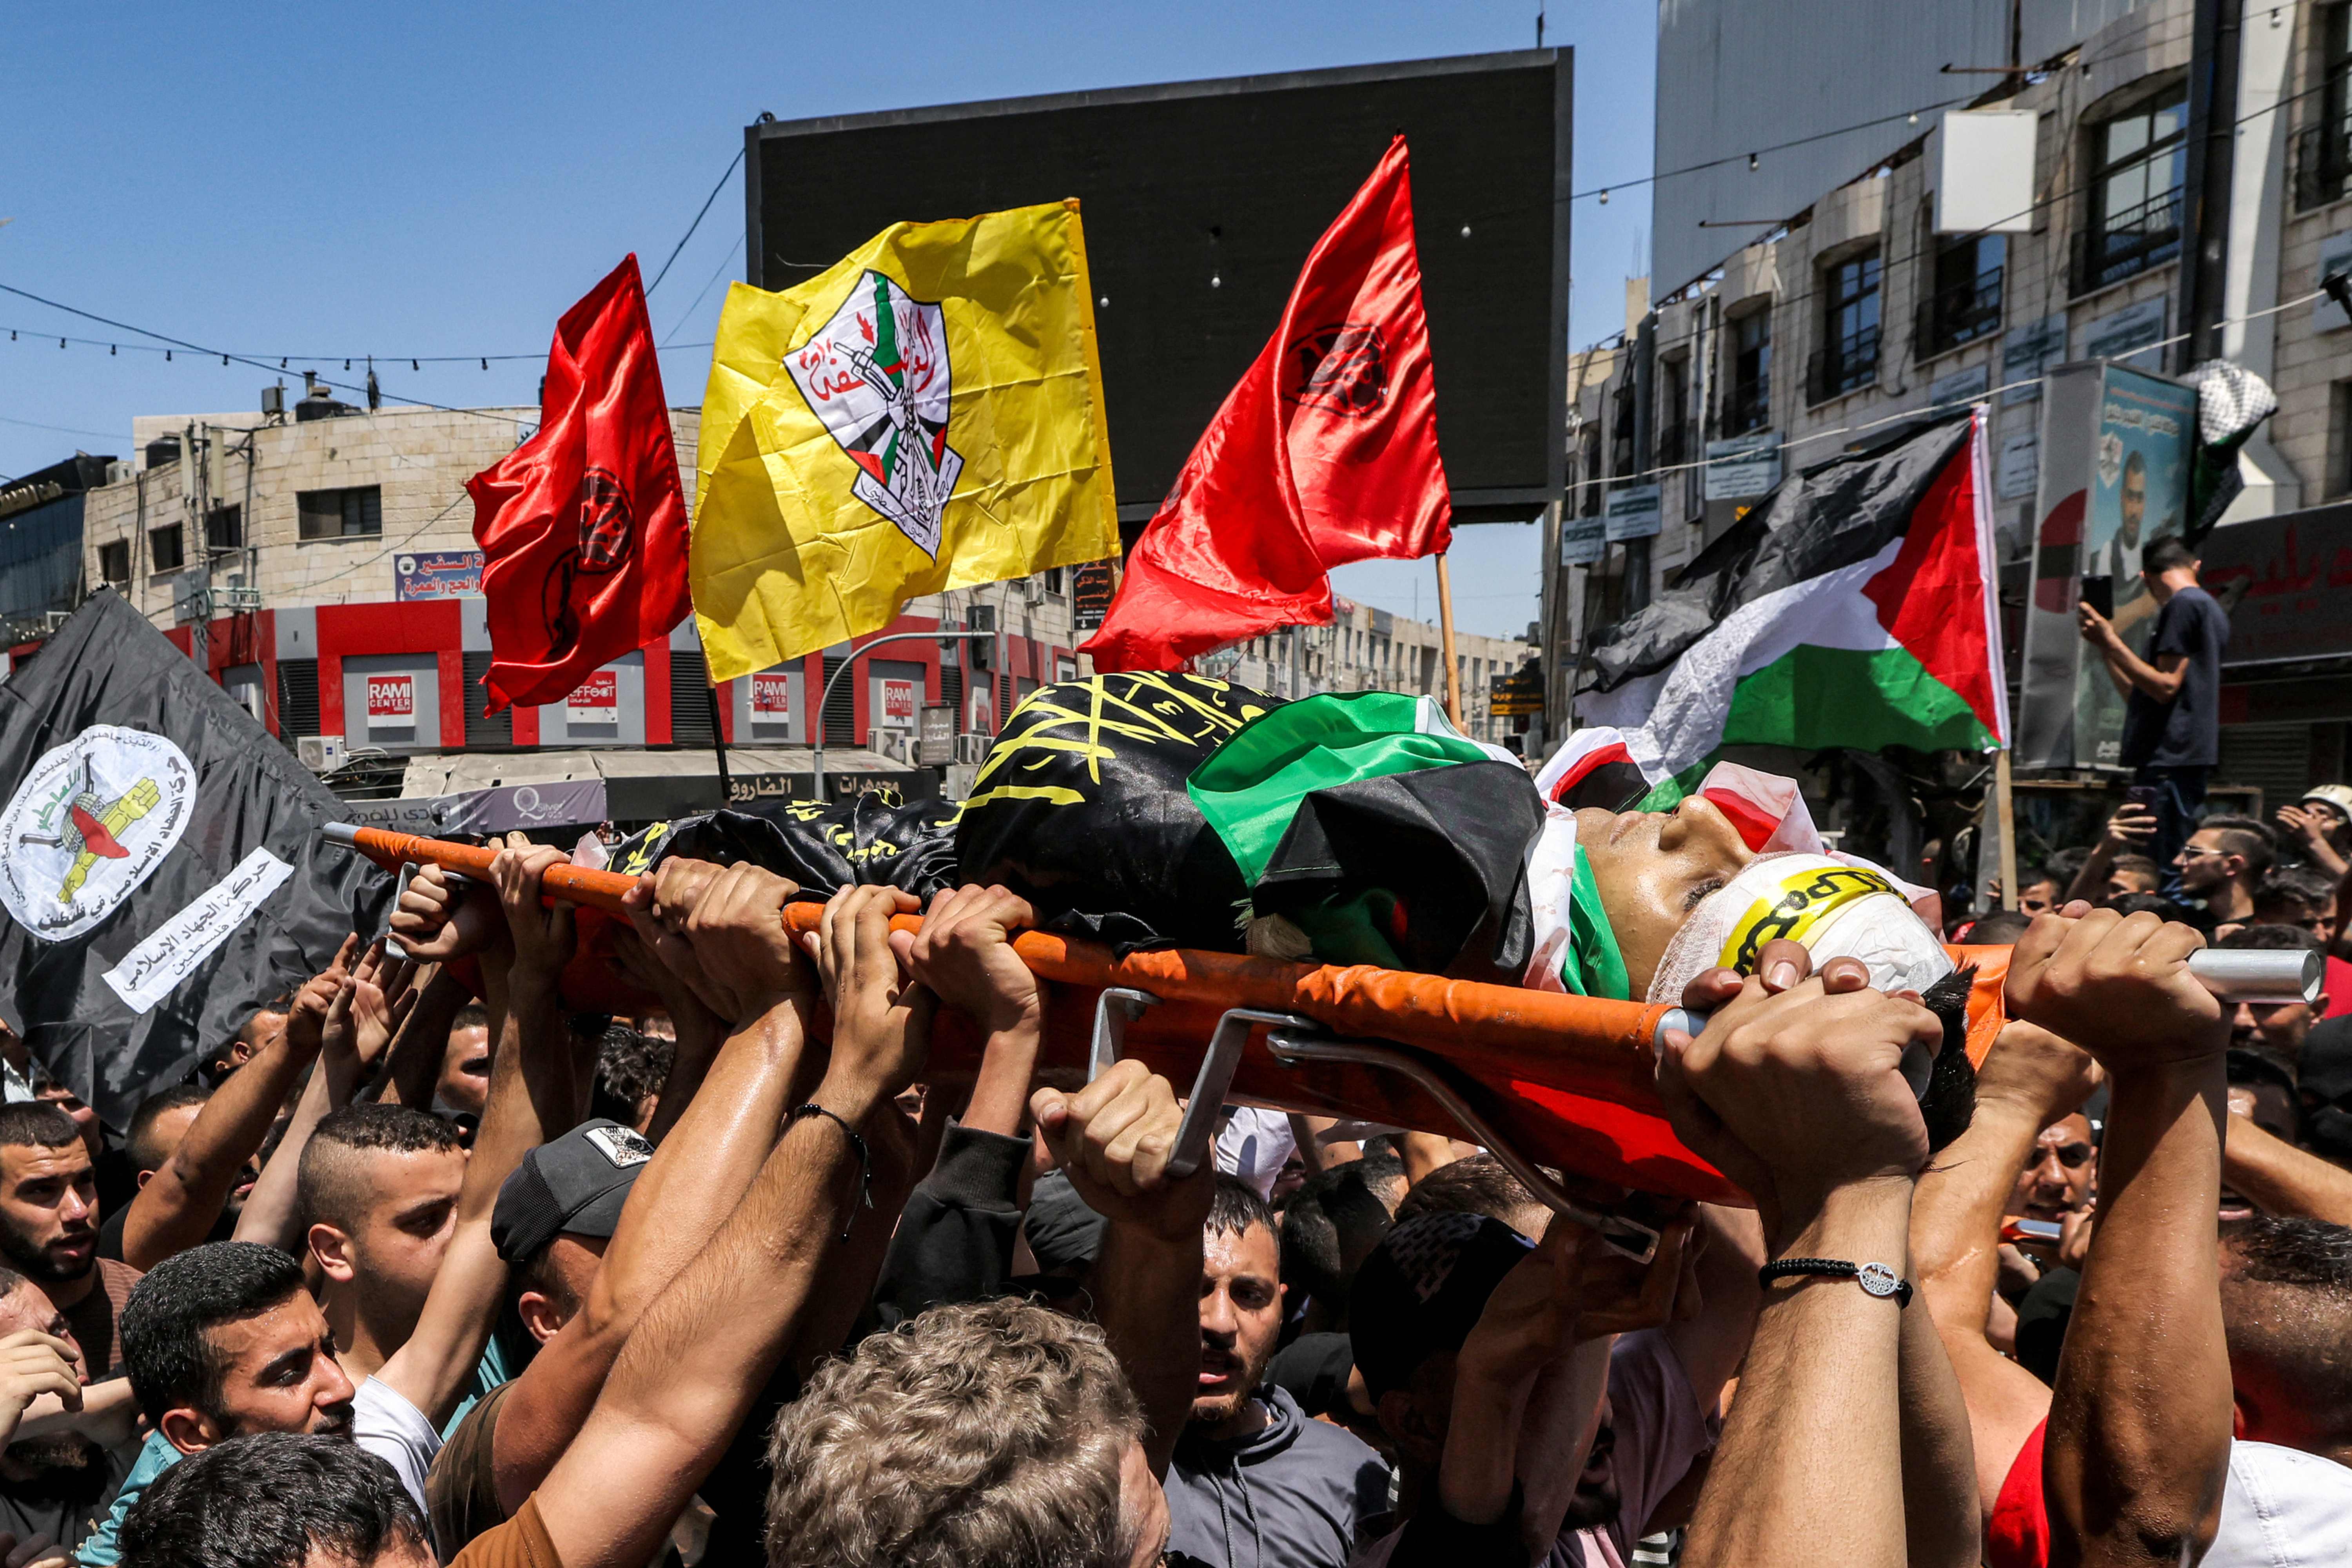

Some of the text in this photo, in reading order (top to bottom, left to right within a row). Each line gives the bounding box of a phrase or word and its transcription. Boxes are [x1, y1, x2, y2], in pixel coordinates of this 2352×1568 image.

[419, 554, 472, 575] السفير
[404, 575, 480, 596] والحج والعمرة
[370, 682, 410, 699] RAMI
[754, 681, 786, 696] RAMI
[886, 687, 911, 701] RAMI
[370, 698, 410, 707] CENTER
[167, 756, 187, 797] حركة
[729, 775, 900, 802] مجوهرات الفاروق
[514, 786, 546, 820] Q
[159, 797, 185, 839] الجهاد
[38, 903, 86, 934] فلسطين
[90, 894, 105, 919] في
[124, 861, 270, 992] حركة الجهاد الإسلامي
[172, 924, 230, 975] فلسطين
